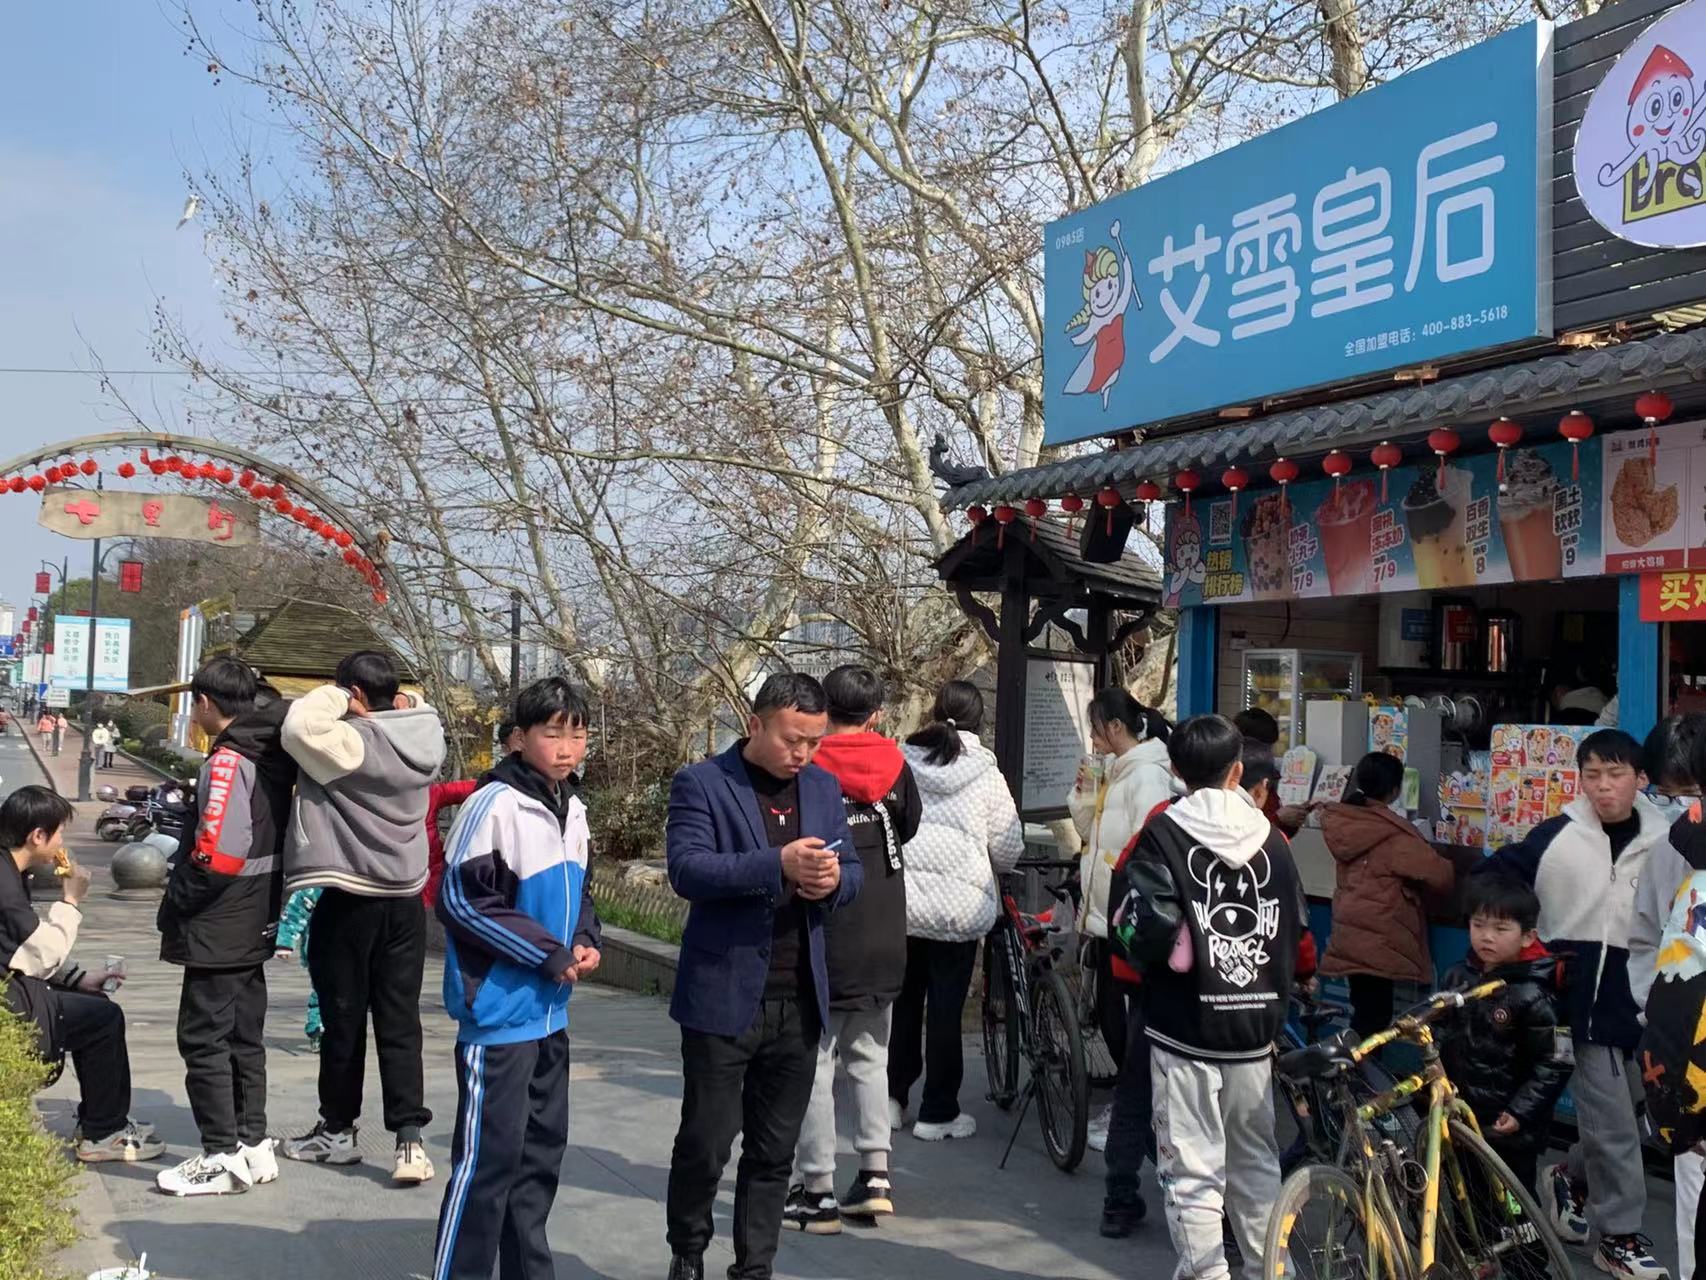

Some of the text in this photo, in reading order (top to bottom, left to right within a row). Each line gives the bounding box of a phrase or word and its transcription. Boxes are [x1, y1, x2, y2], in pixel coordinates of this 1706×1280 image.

[1055, 227, 1085, 250] 0985店
[1148, 121, 1505, 363] 艾雪皇后
[1422, 304, 1509, 337] 400-883-5618
[1476, 557, 1486, 574] 8
[1566, 549, 1576, 565] 9
[1292, 573, 1313, 591] 7/9
[1373, 561, 1396, 583] 7/9
[1204, 574, 1244, 596] 排行榜
